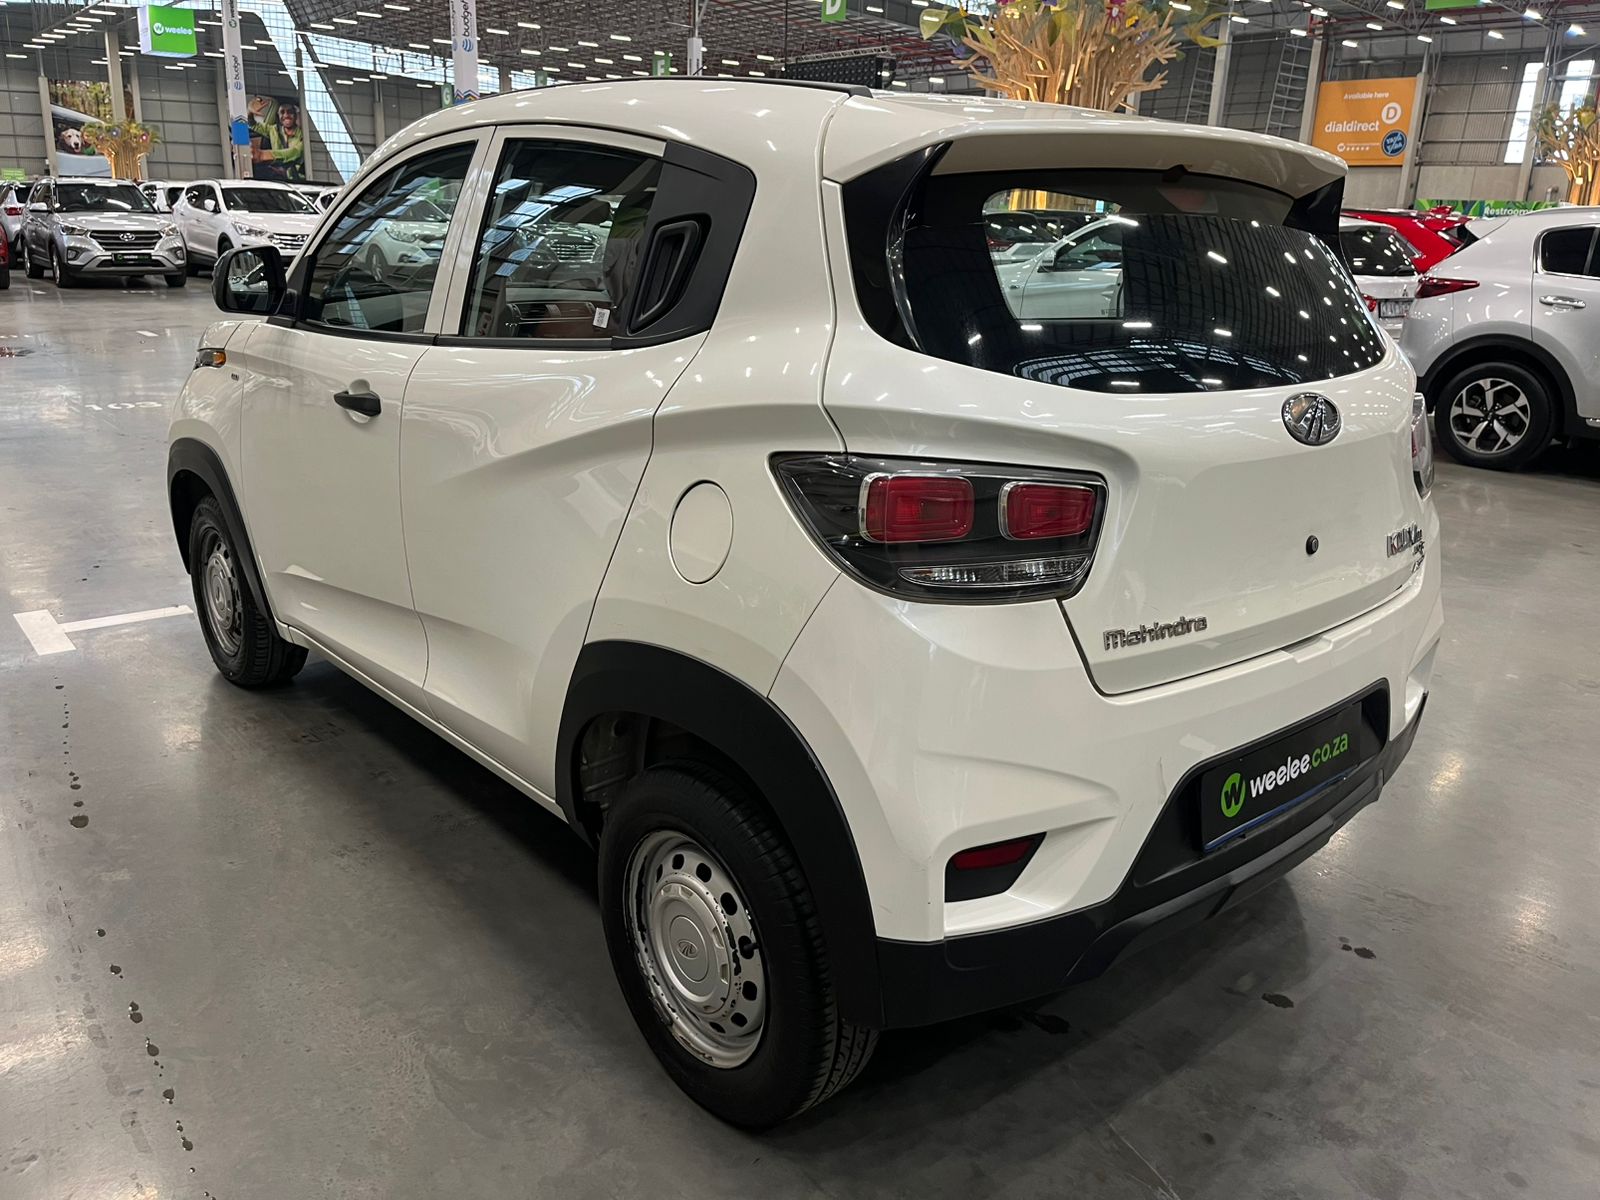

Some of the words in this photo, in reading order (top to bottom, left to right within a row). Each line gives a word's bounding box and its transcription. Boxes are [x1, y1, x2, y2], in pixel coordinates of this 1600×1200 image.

[1325, 120, 1380, 133] dialdirect
[1484, 204, 1532, 216] Restroom
[1103, 616, 1208, 651] Mahindra
